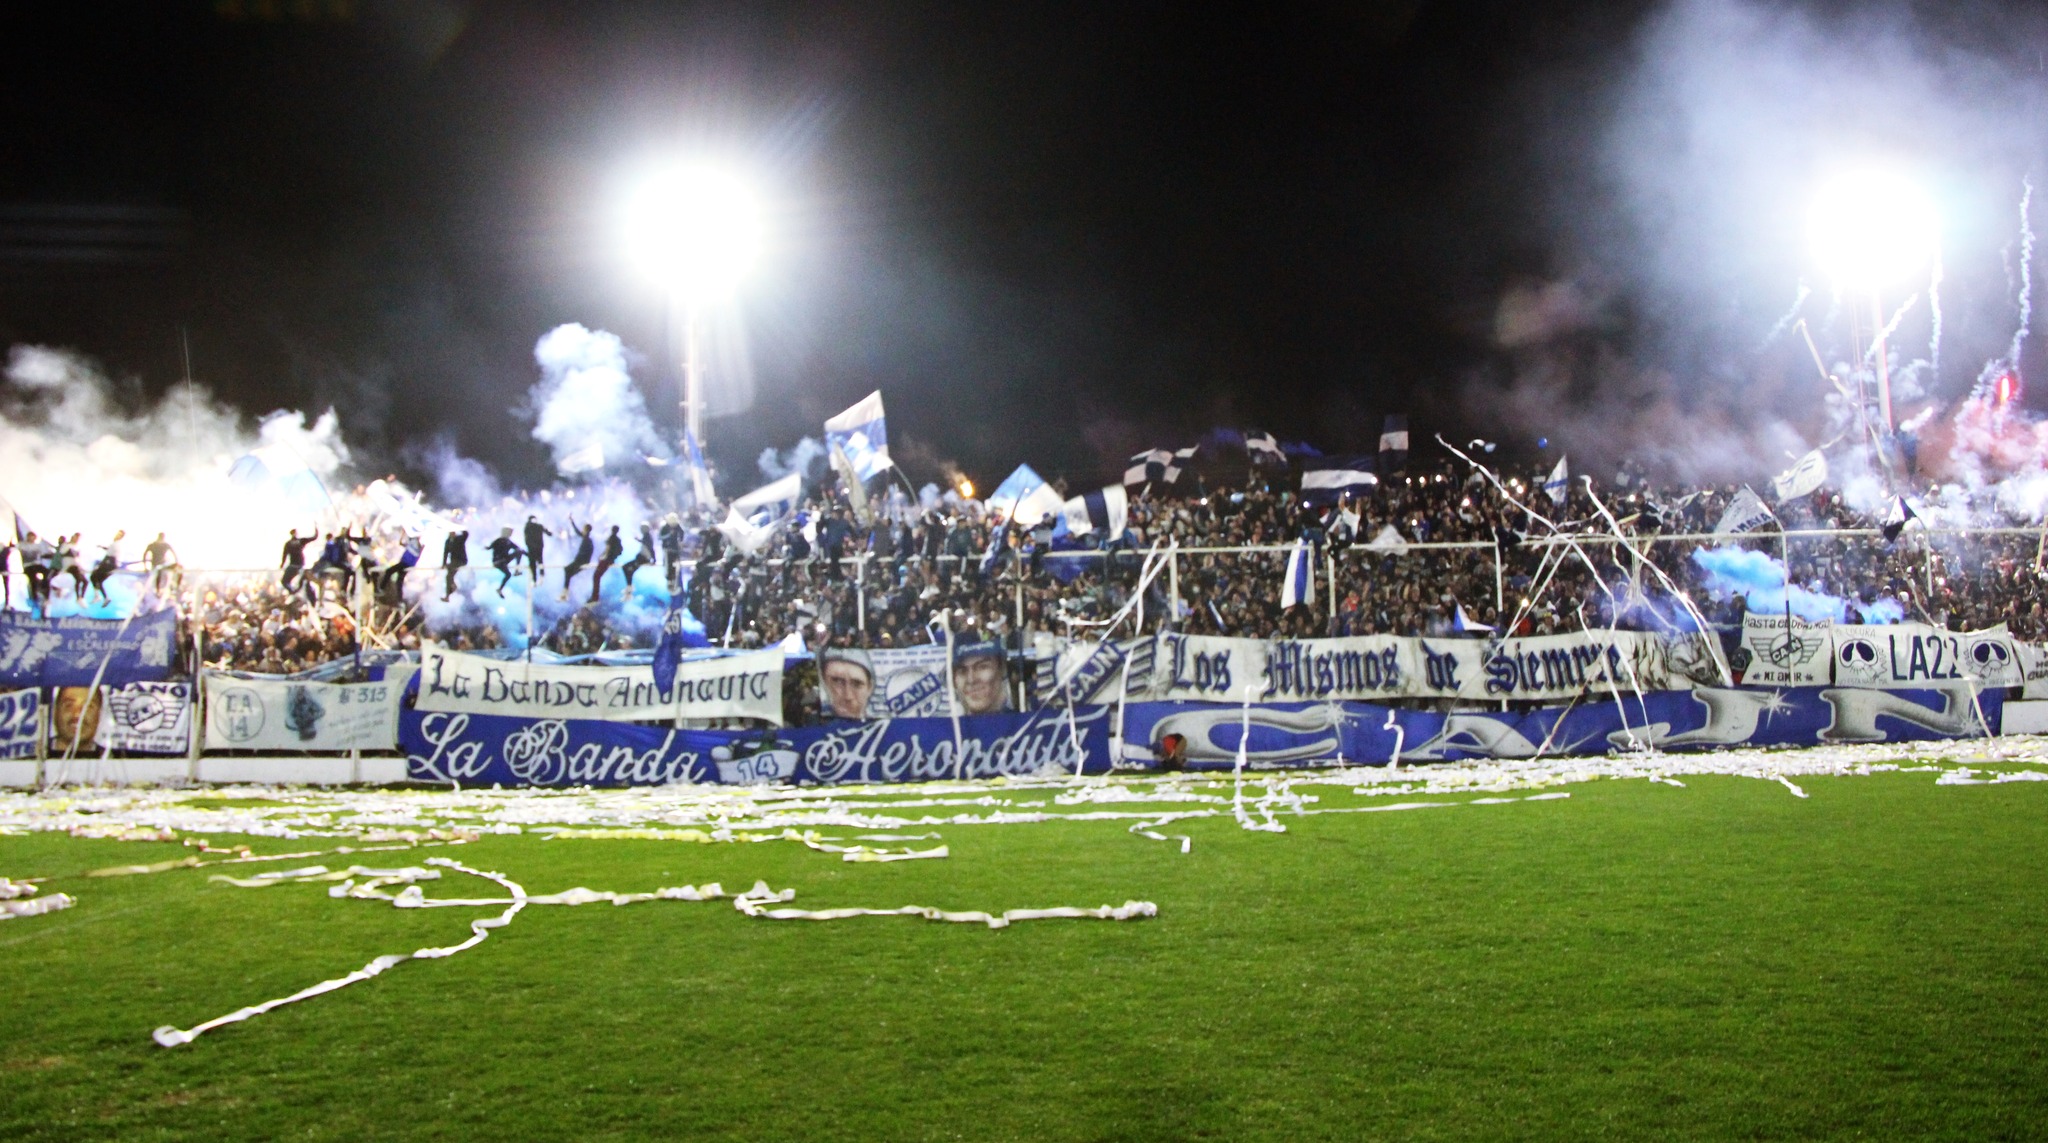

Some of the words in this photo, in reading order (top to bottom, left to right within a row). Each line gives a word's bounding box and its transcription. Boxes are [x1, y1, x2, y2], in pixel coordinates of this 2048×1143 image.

[1166, 635, 1232, 694] Los
[1260, 640, 1400, 698] Mismos
[1420, 638, 1462, 691] de
[1772, 638, 1802, 662] CAN
[429, 654, 471, 699] La
[481, 667, 599, 708] Banda
[889, 675, 937, 712] CAJN
[406, 712, 494, 784] La
[503, 719, 707, 787] Banda
[805, 705, 1108, 782] Aeronauta
[736, 752, 780, 781] 14
